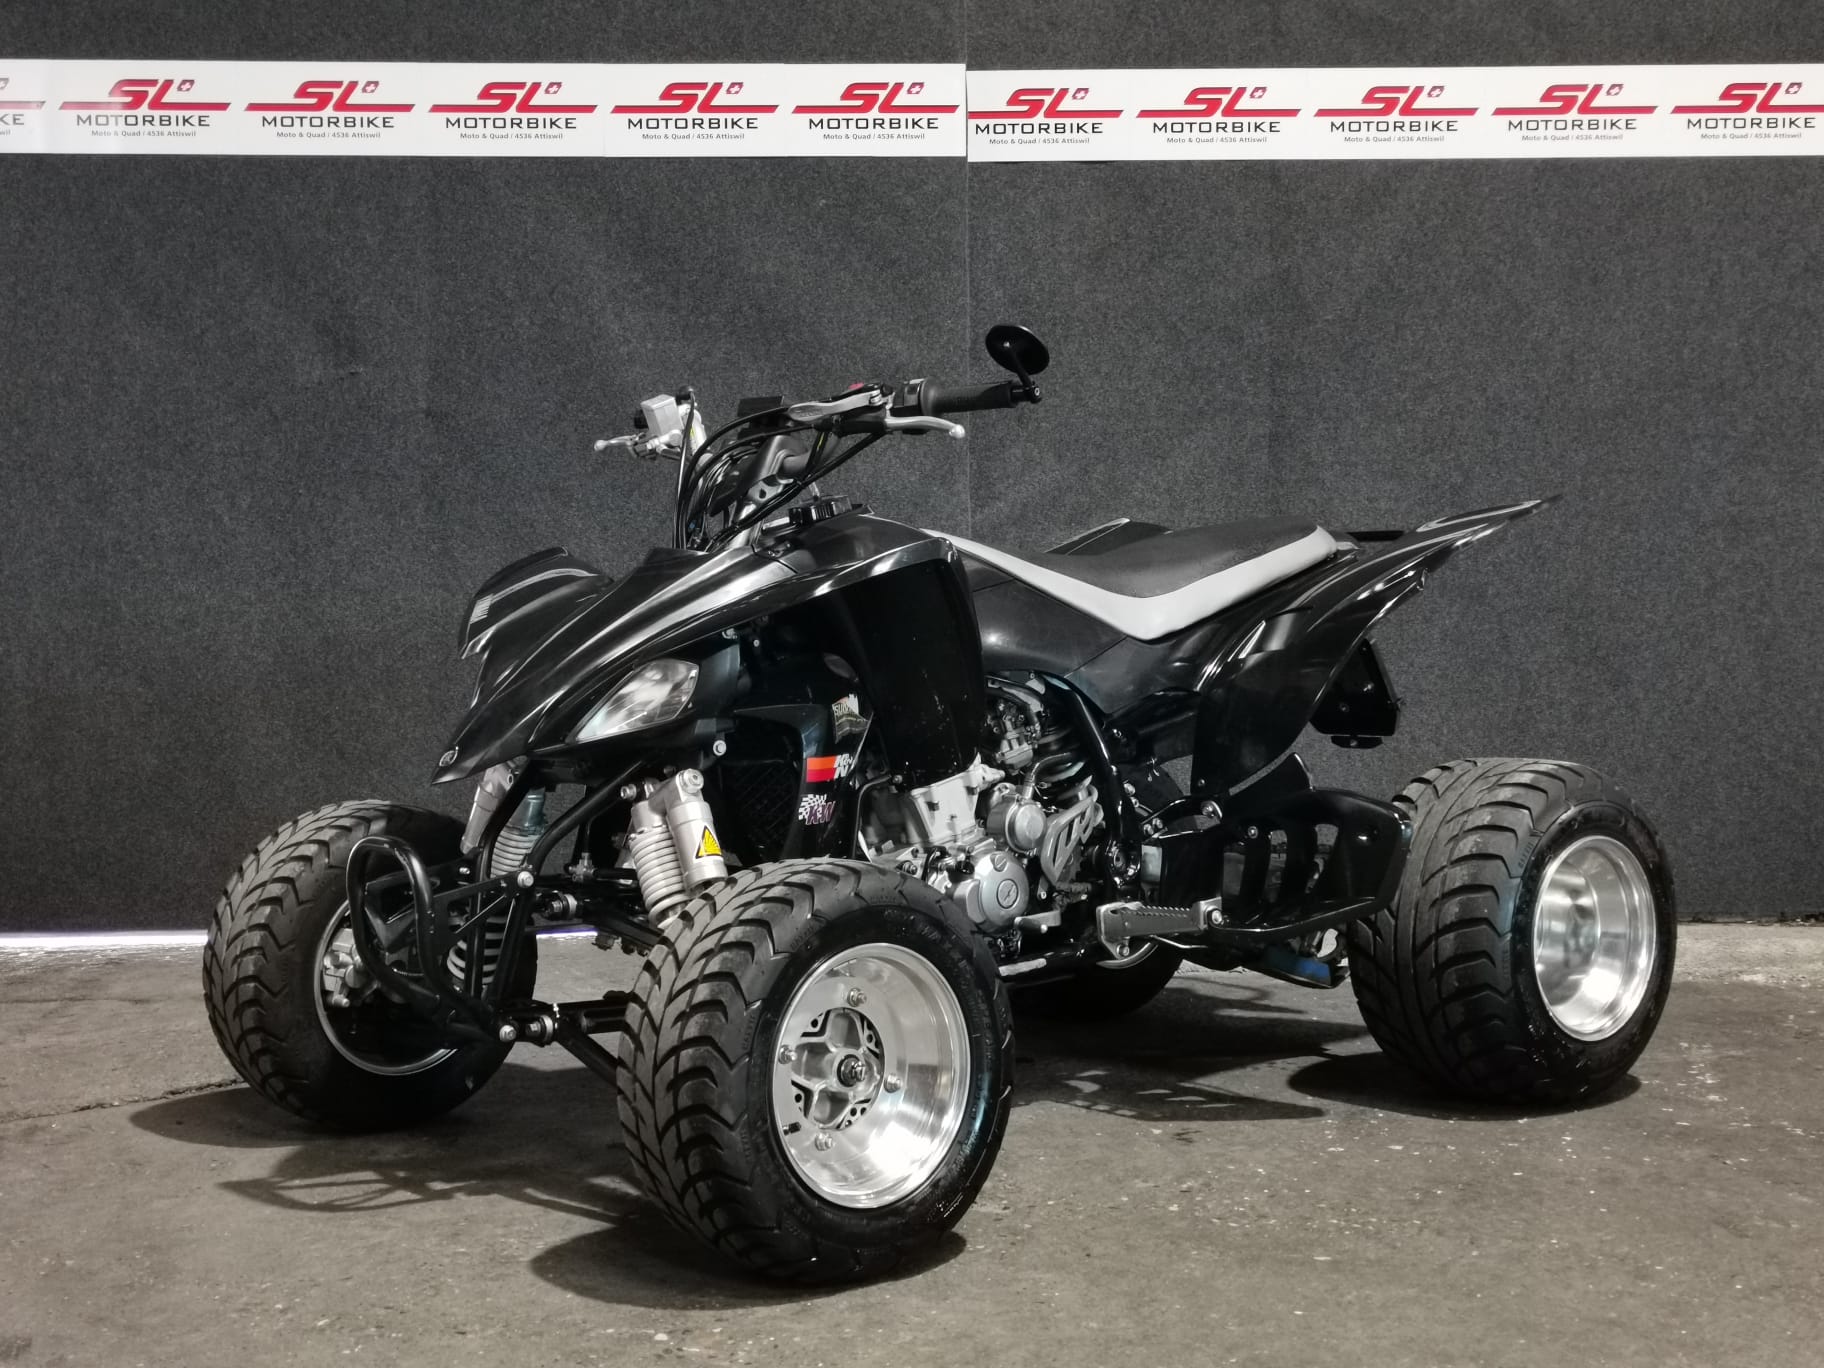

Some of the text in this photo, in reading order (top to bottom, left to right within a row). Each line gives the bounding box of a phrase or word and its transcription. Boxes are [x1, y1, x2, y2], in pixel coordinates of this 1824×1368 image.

[77, 113, 210, 127] MOTORBIKE
[262, 115, 395, 128] MOTORBIKE
[446, 116, 577, 129] MOTORBIKE
[628, 117, 759, 130] MOTORBIKE
[809, 117, 940, 130] MOTORBIKE
[1331, 119, 1459, 132] MOTORBIKE
[1508, 118, 1638, 131] MOTORBIKE
[1687, 116, 1817, 129] MOTORBIKE
[975, 121, 1104, 135] MOTORBIKE
[1153, 120, 1281, 134] MOTORBIKE
[91, 129, 112, 138] Moto
[121, 129, 141, 138] Quad
[276, 131, 296, 140] Moto
[306, 131, 326, 140] Quad
[331, 131, 349, 140] 4536
[351, 131, 381, 140] Attiswil
[459, 132, 479, 141] Moto
[489, 132, 509, 141] Quad
[514, 132, 532, 141] 4536
[534, 132, 564, 141] Attiswil
[641, 132, 661, 141] Moto
[670, 132, 690, 141] Quad
[695, 132, 714, 141] 4536
[715, 132, 745, 141] Attiswil
[822, 132, 842, 141] Moto
[851, 132, 871, 141] Quad
[876, 132, 895, 141] 4536
[896, 132, 926, 141] Attiswil
[1521, 134, 1541, 143] Moto
[1550, 134, 1570, 143] Quad
[1575, 134, 1594, 143] 4536
[1595, 134, 1625, 143] Attiswil
[1699, 132, 1719, 141] Moto
[1728, 132, 1748, 141] Quad
[988, 137, 1008, 145] Moto
[1017, 137, 1037, 145] Quad
[1042, 137, 1060, 145] 4536
[1061, 137, 1091, 145] Attiswil
[1166, 136, 1186, 144] Moto
[1195, 136, 1215, 144] Quad
[1220, 136, 1238, 144] 4536
[1239, 136, 1269, 144] Attiswil
[1343, 135, 1363, 144] Moto
[1372, 135, 1392, 144] Quad
[1397, 135, 1415, 144] 4536
[1416, 135, 1446, 144] Attiswil
